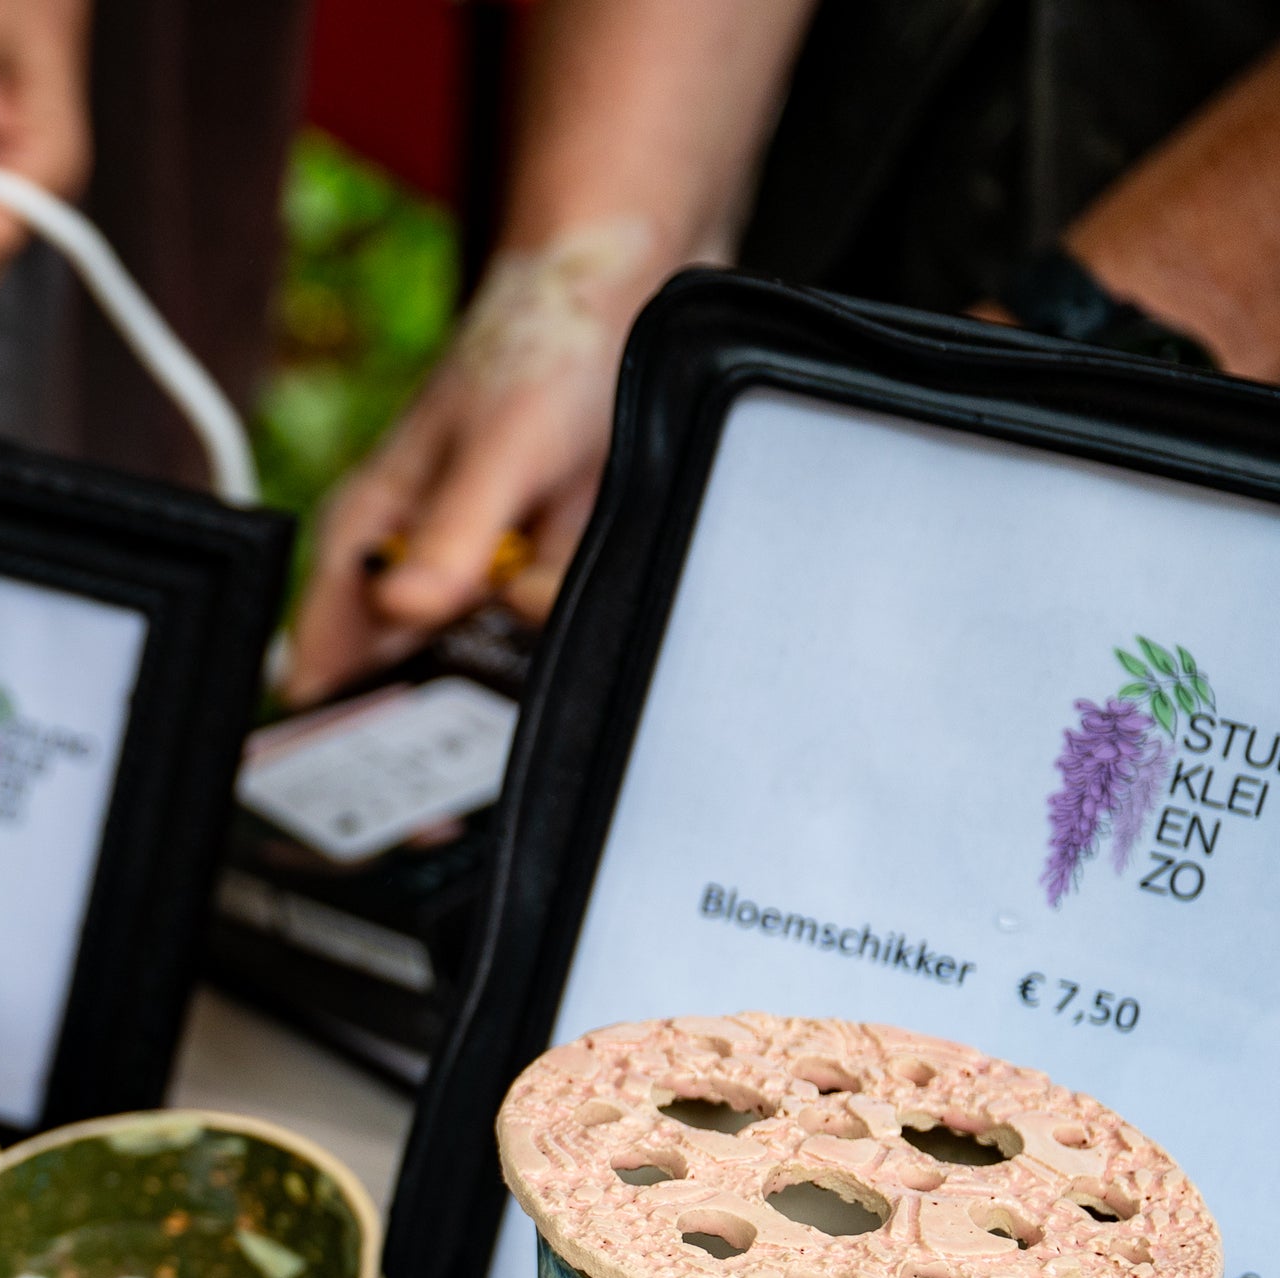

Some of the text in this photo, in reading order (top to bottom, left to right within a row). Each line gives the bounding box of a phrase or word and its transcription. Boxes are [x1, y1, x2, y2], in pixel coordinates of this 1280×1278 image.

[1183, 712, 1280, 773] STU
[1169, 758, 1270, 820] KLEI
[1156, 805, 1221, 858] EN
[1139, 850, 1206, 902] ZO
[699, 882, 1140, 1033] Bloemschikker € 7,50
